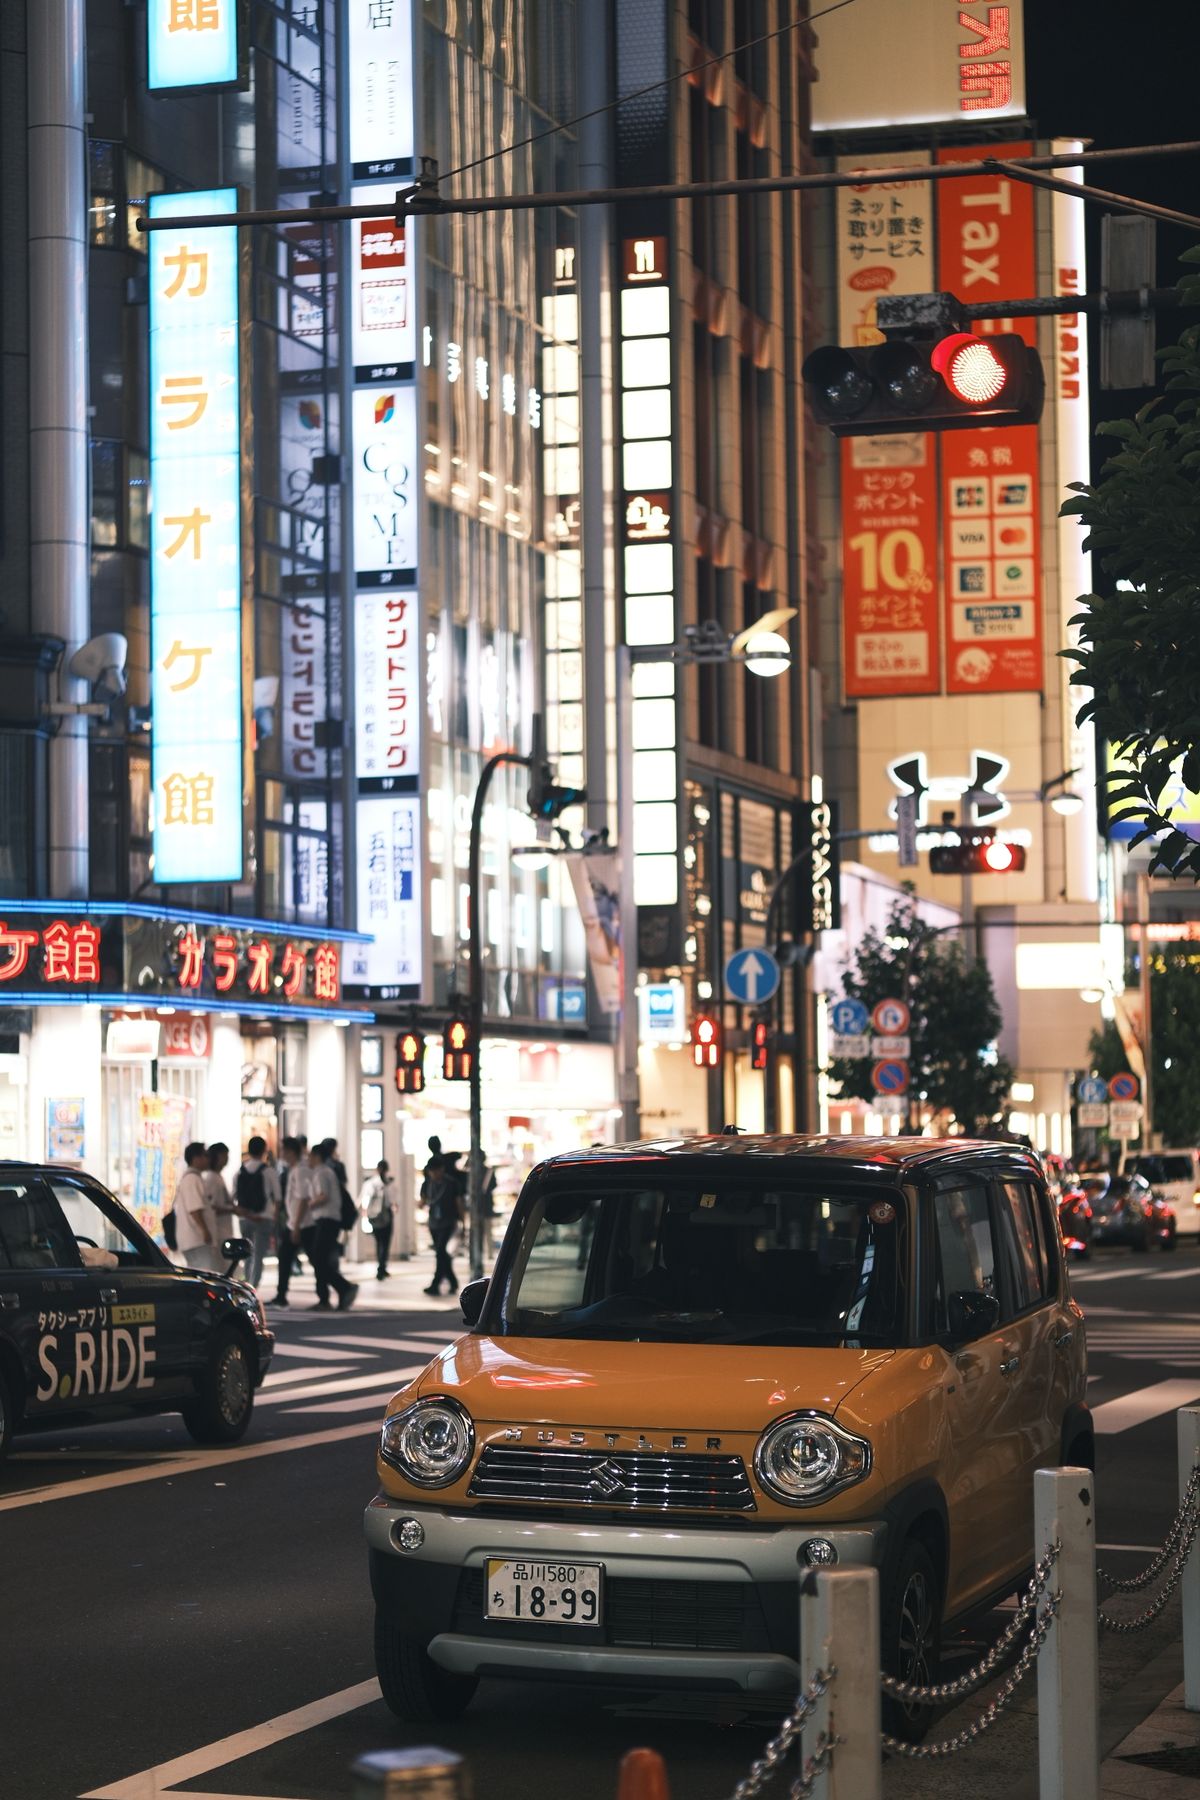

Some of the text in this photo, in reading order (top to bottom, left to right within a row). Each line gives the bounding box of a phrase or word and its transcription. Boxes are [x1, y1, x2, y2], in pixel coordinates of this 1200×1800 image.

[959, 0, 1011, 111] メラ
[848, 197, 904, 215] ネット
[848, 216, 925, 238] 取り置き
[961, 181, 1012, 288] Tax
[848, 239, 925, 260] サービス
[968, 446, 1013, 468] 免税
[863, 472, 916, 491] ビック
[855, 491, 925, 512] ポイント
[160, 244, 215, 826] カラオケ館
[959, 531, 985, 544] VISA
[859, 595, 924, 612] ポイント
[859, 612, 925, 630] サービス
[178, 931, 340, 1001] カラオケ館
[36, 1326, 157, 1401] S.RIDE
[505, 1428, 722, 1450] HUSTLER
[515, 1584, 598, 1621] 18-99
